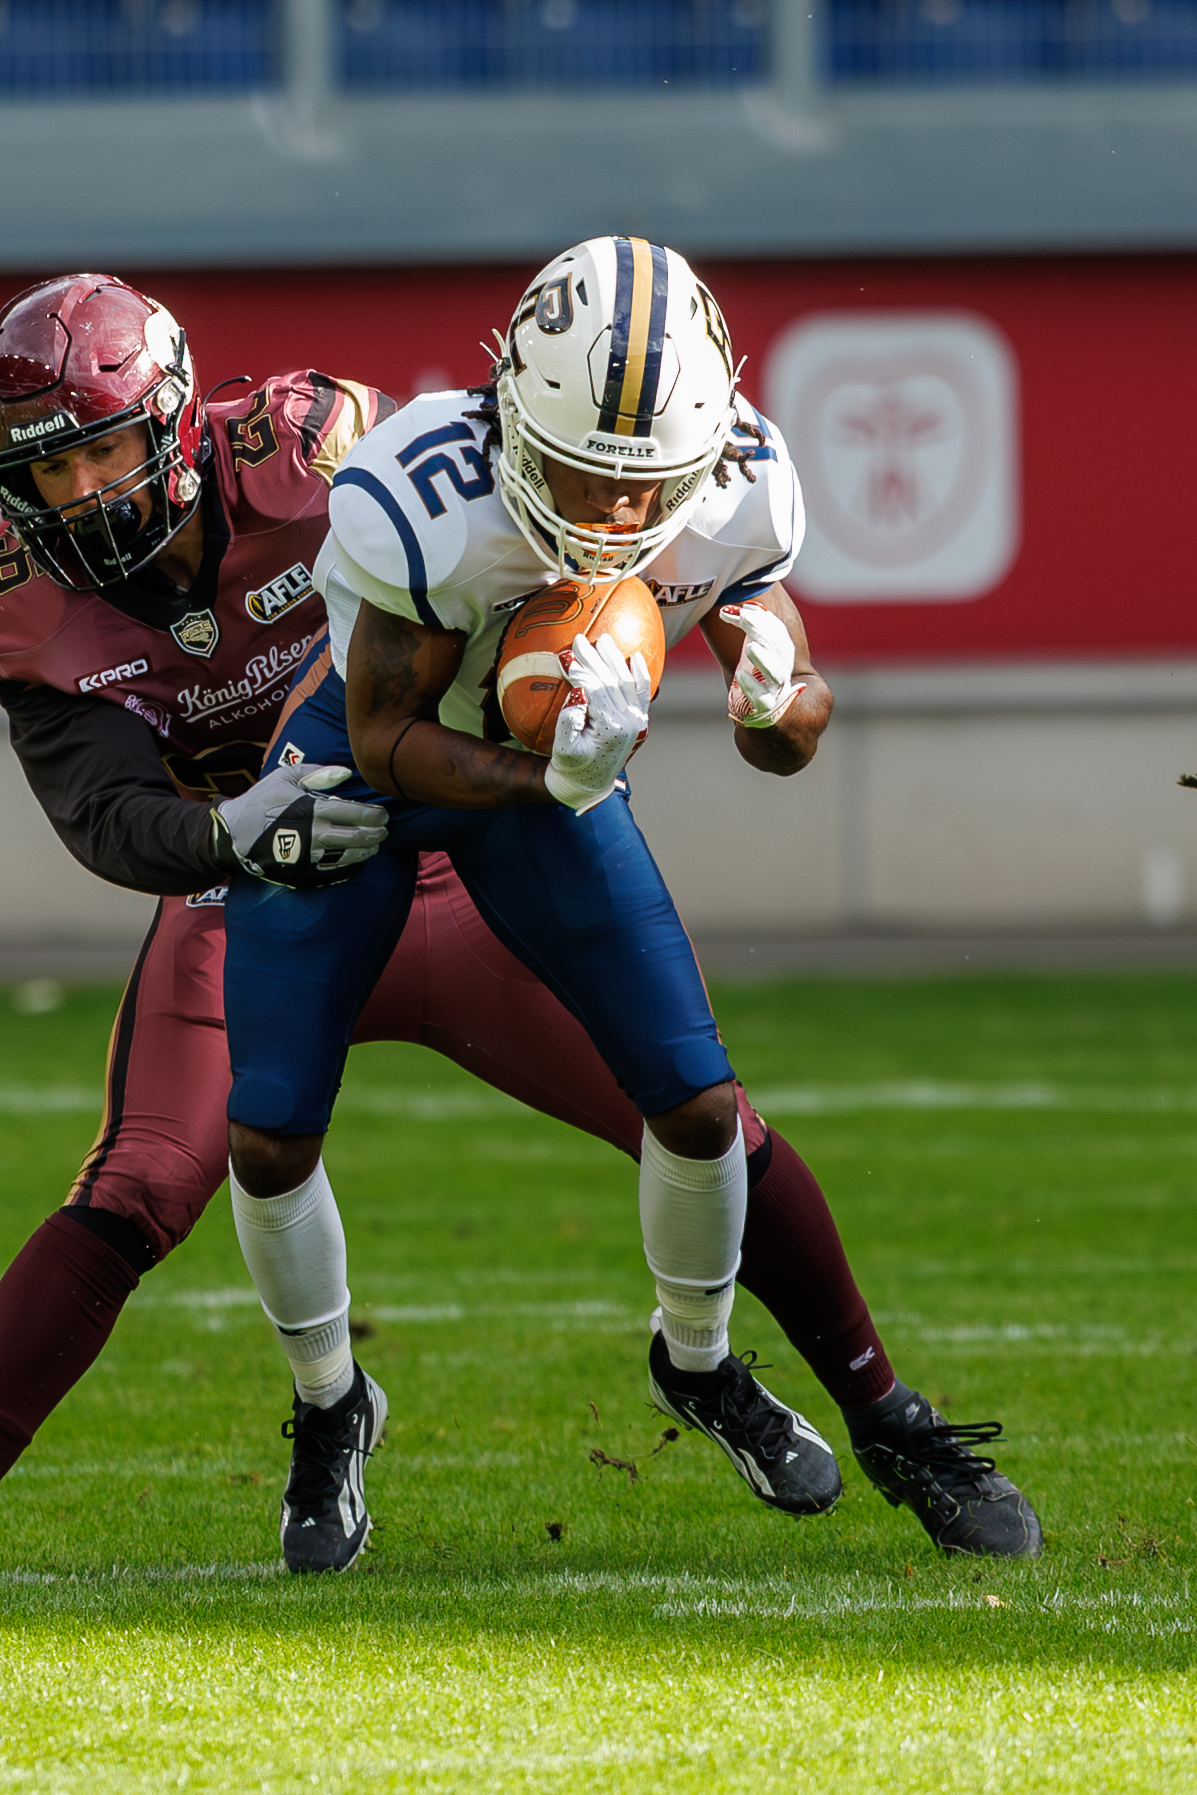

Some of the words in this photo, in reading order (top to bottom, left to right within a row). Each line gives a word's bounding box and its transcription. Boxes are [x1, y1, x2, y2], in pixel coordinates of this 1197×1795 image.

[10, 413, 66, 442] Riddell
[512, 445, 545, 490] ddell
[586, 439, 655, 459] FORELLE
[394, 420, 496, 521] 12
[261, 567, 312, 617] AFLE
[654, 580, 712, 603] AFLE
